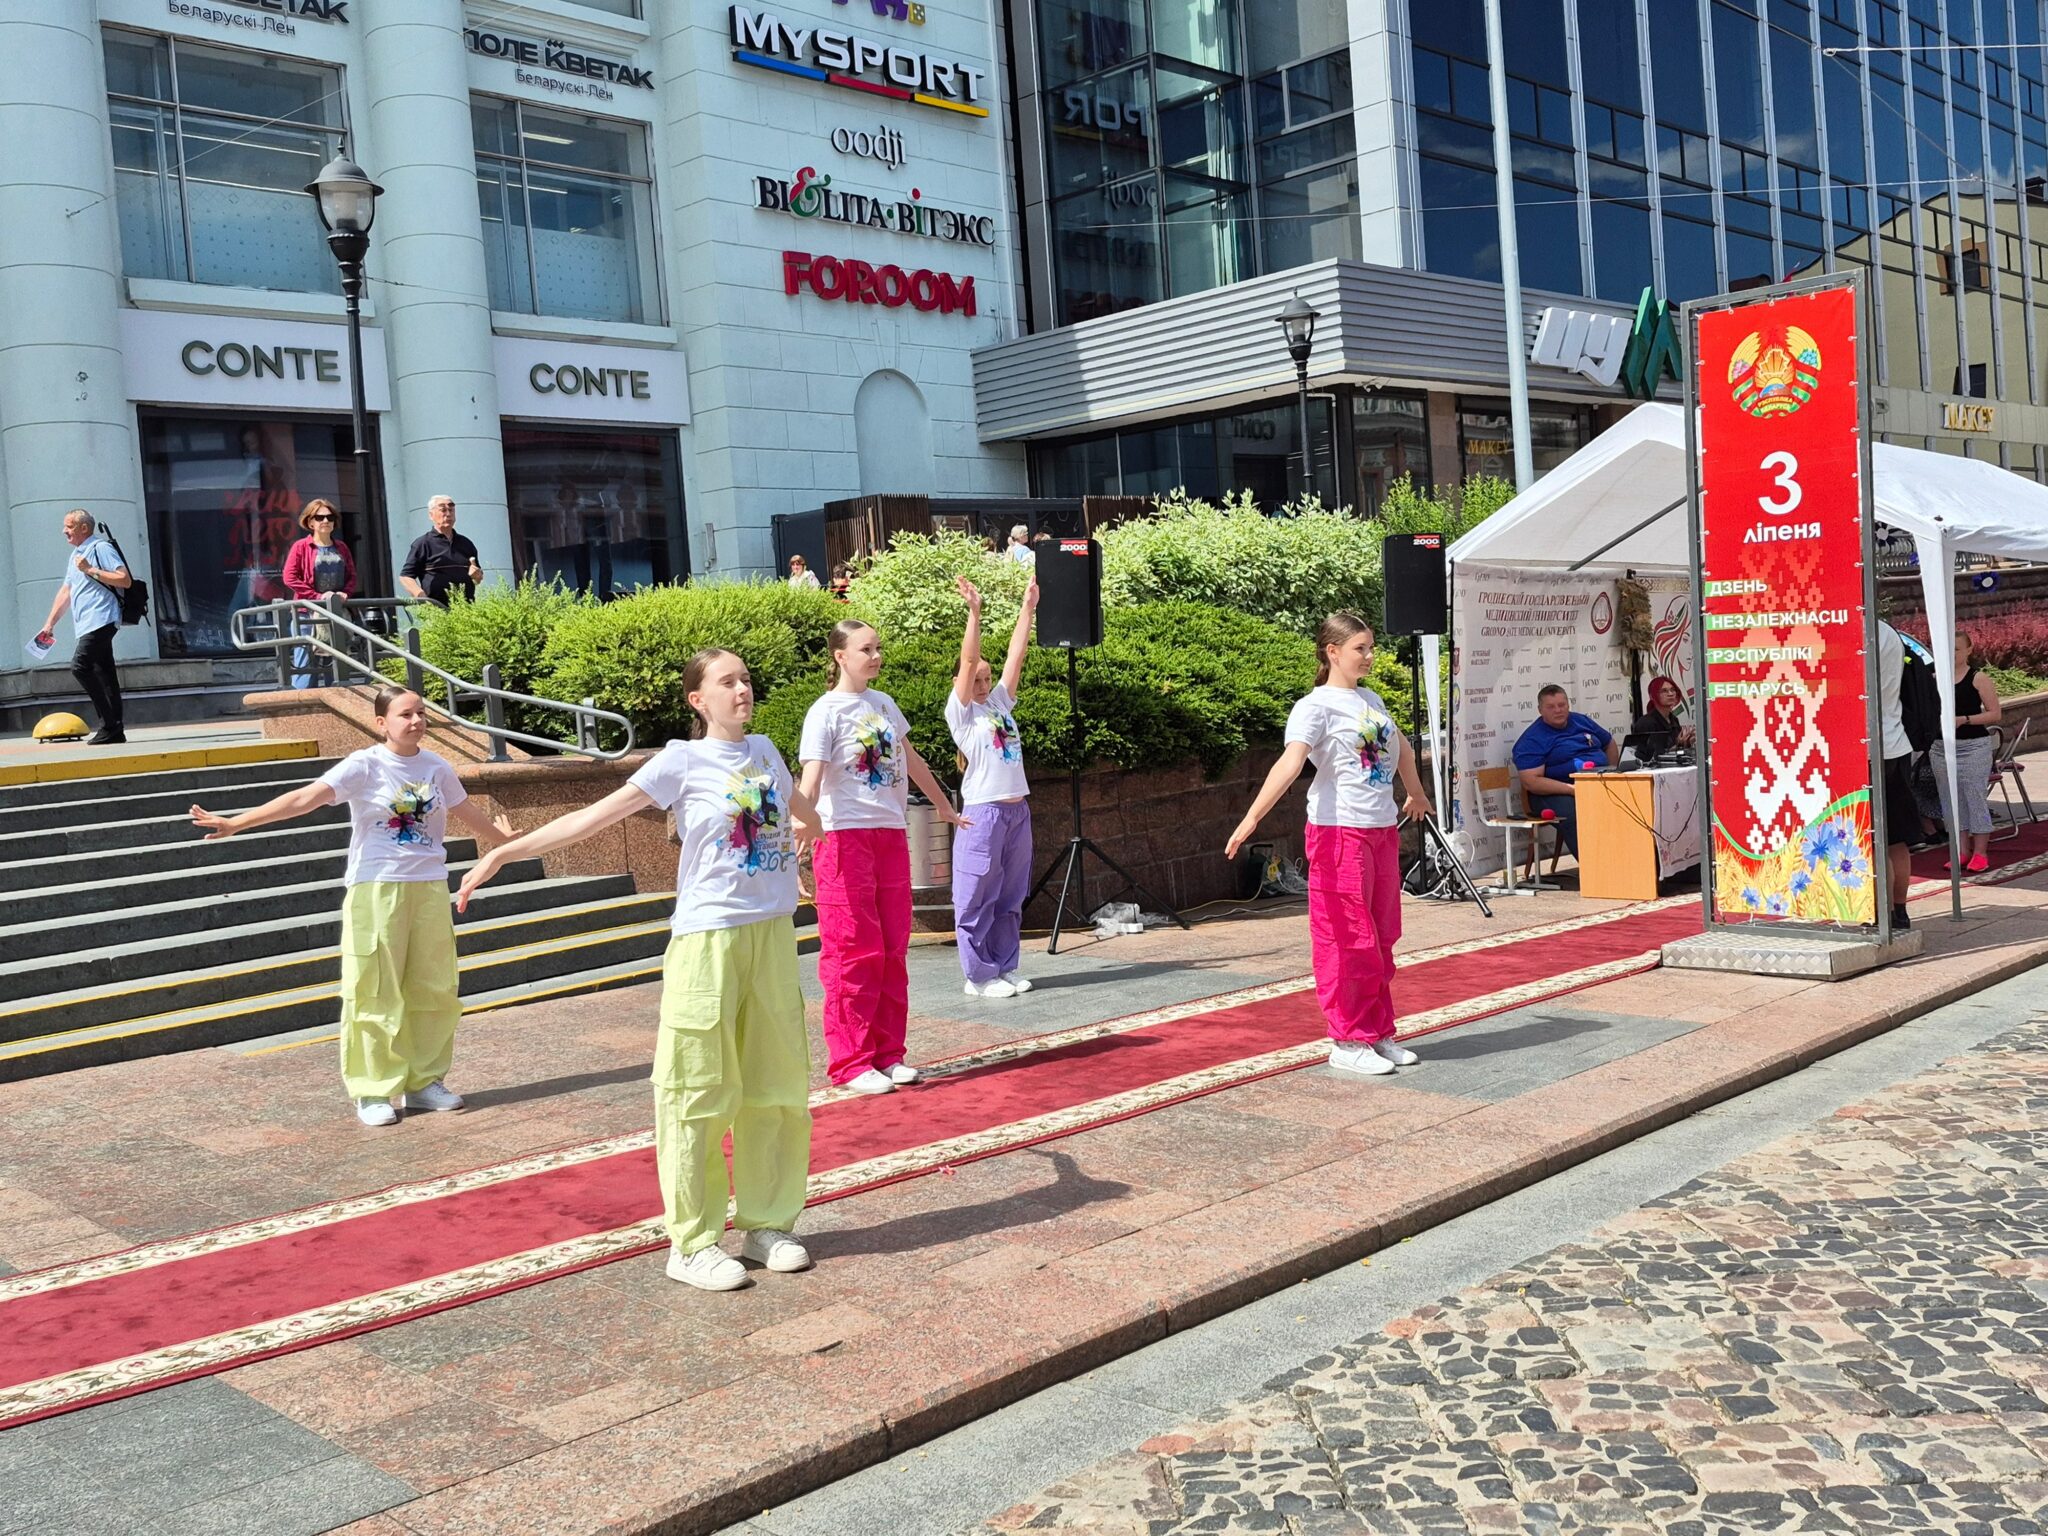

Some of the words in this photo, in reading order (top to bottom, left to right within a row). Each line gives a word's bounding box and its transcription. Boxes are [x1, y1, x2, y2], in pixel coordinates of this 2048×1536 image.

[463, 28, 539, 63] ПОЛЕ
[545, 47, 655, 89] КВЕТАК
[831, 125, 907, 170] oodji
[782, 250, 977, 317] FOROOM
[182, 340, 341, 382] CONTE
[530, 362, 651, 399] CONTE
[1758, 451, 1802, 515] 3
[1060, 543, 1088, 551] 2000
[1743, 522, 1822, 543] ліпеня
[1710, 580, 1768, 597] ДЗЕНЬ
[1711, 609, 1848, 630] НЕЗАЛЕЖНАСЦІ
[1712, 647, 1813, 664] РЭСПУБЛІКІ
[1714, 682, 1806, 698] БЕЛАРУСЬ
